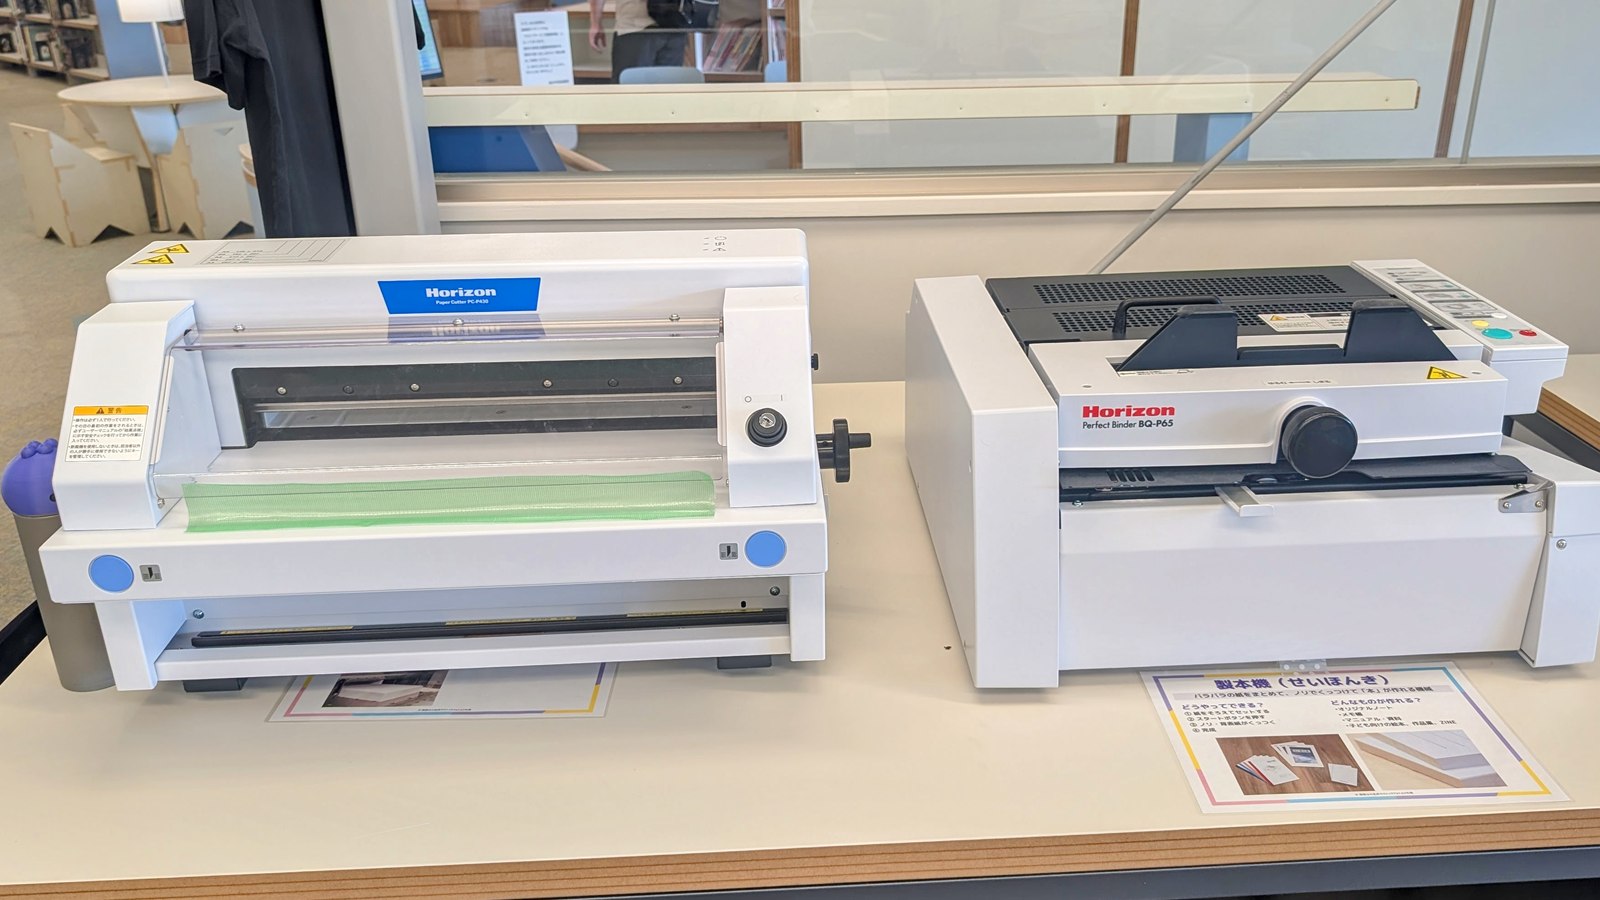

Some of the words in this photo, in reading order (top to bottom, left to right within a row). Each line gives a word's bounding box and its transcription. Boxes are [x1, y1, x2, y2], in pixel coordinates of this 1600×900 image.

[425, 287, 497, 298] Horizon
[1082, 405, 1176, 418] Horizon
[1082, 420, 1111, 429] Perfect
[1111, 420, 1137, 429] Binder
[1138, 419, 1174, 428] BQ-P65
[1214, 674, 1389, 691] 製本機（せいほんき）
